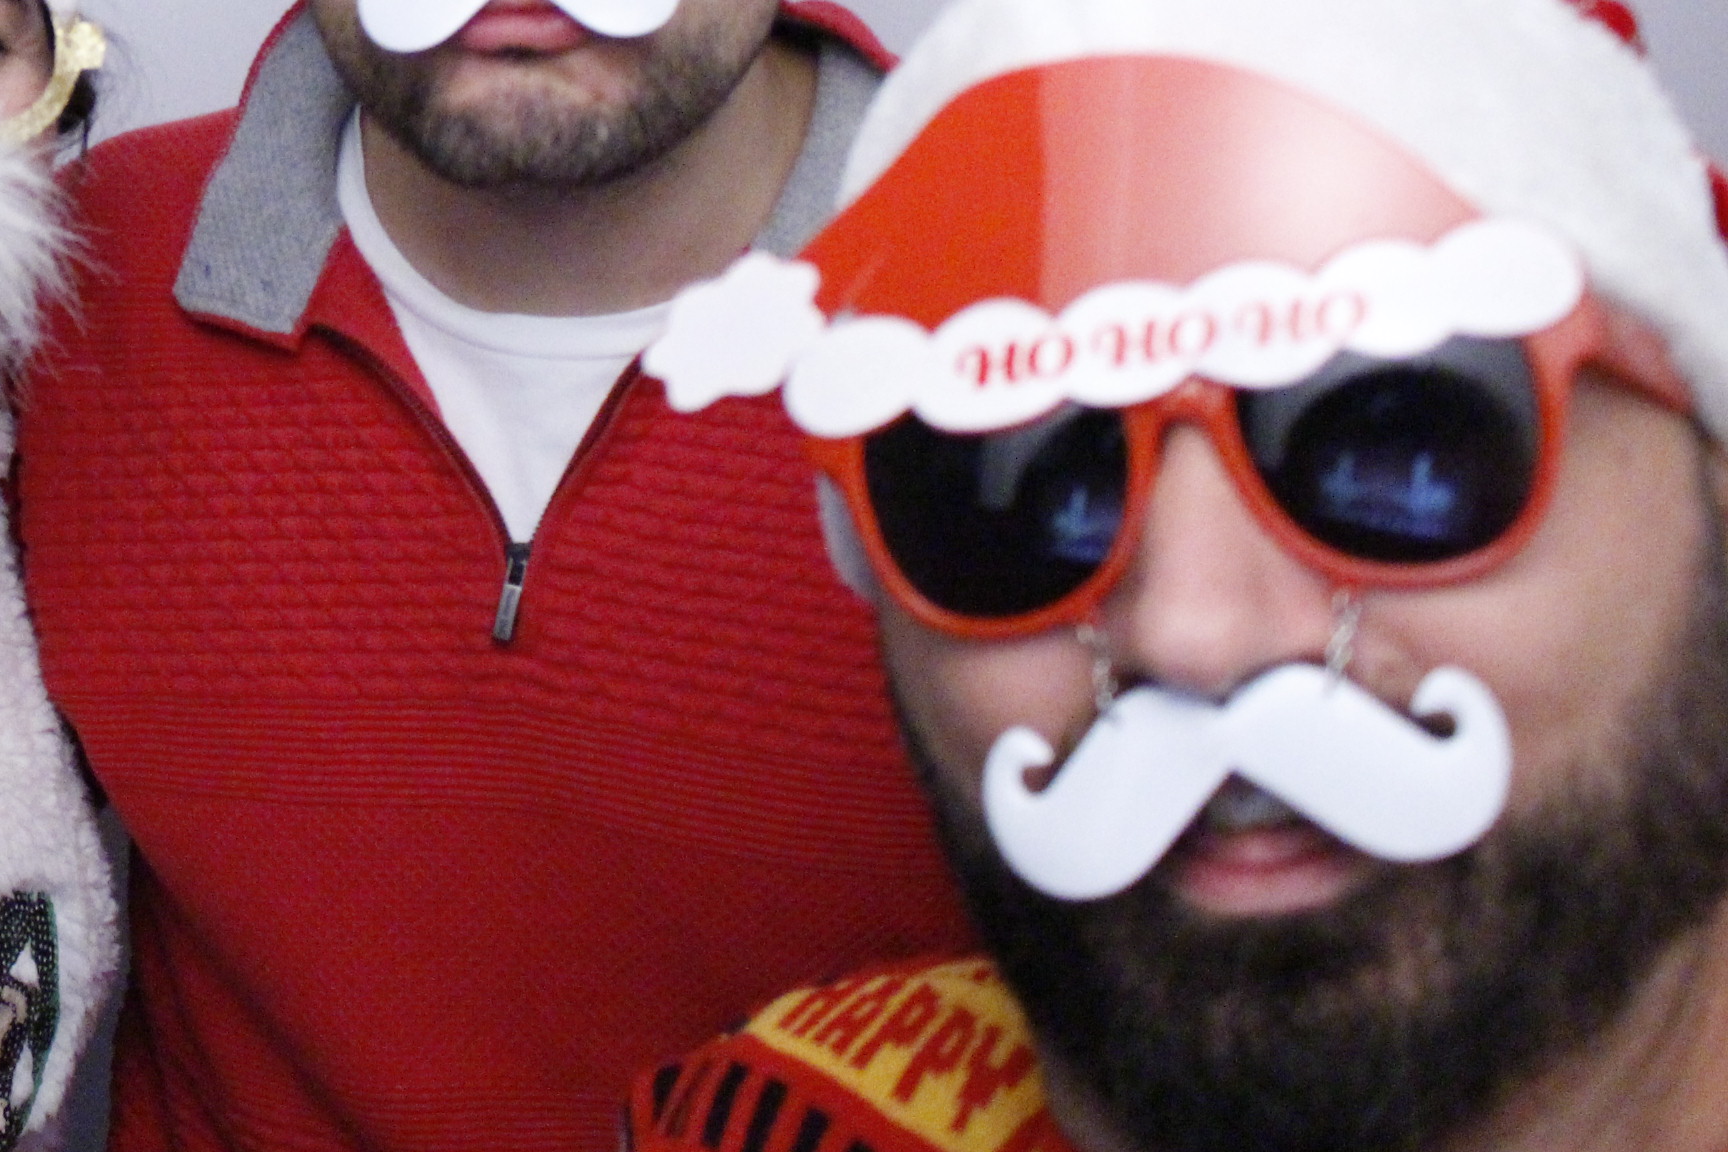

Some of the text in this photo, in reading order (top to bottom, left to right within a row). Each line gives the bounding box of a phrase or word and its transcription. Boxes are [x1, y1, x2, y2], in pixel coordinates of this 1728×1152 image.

[956, 289, 1370, 388] HO HO HO
[778, 974, 1036, 1133] HAPPY
